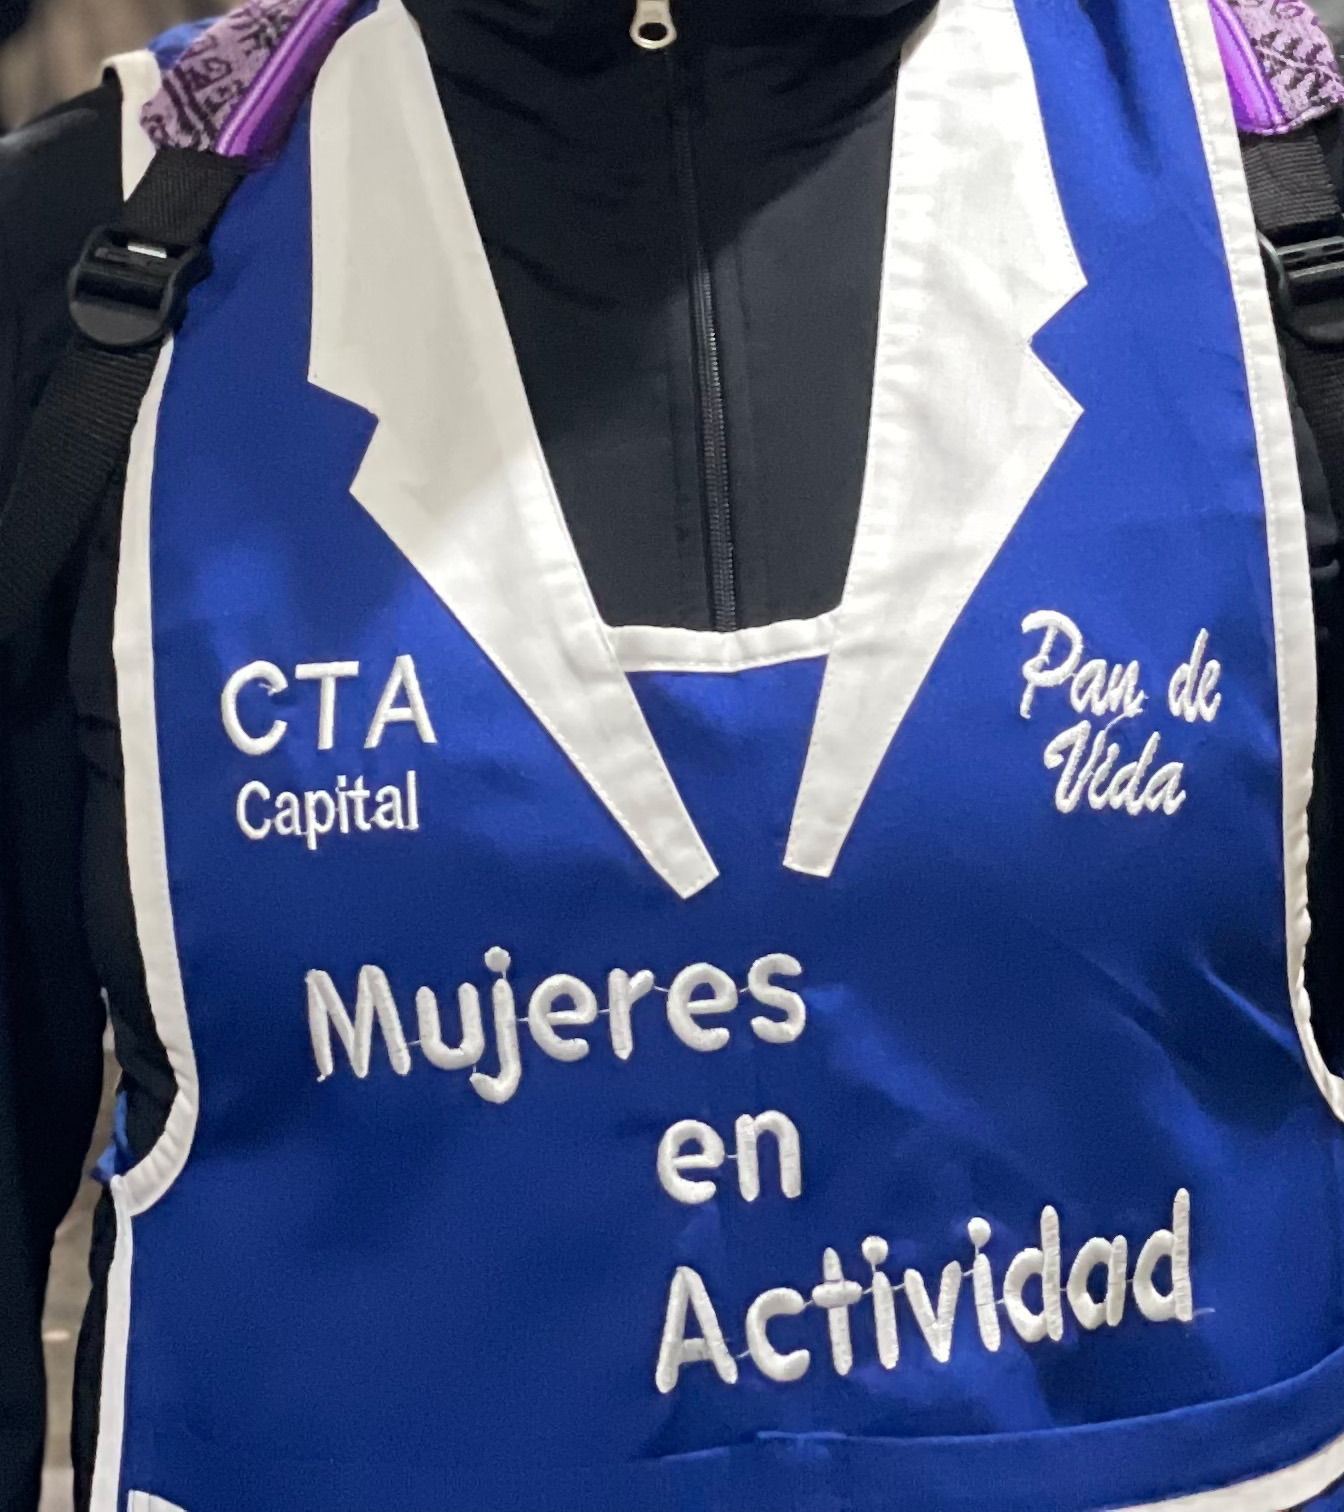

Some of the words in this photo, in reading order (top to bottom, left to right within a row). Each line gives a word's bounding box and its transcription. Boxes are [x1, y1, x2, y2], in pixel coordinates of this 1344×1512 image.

[222, 654, 437, 755] CTA
[1020, 609, 1146, 720] Pan
[1167, 627, 1222, 723] de
[237, 770, 419, 850] Capital
[1043, 719, 1187, 816] Vida
[305, 946, 806, 1103] Mujeres
[657, 1111, 800, 1203] en
[656, 1188, 1193, 1393] Actividad
